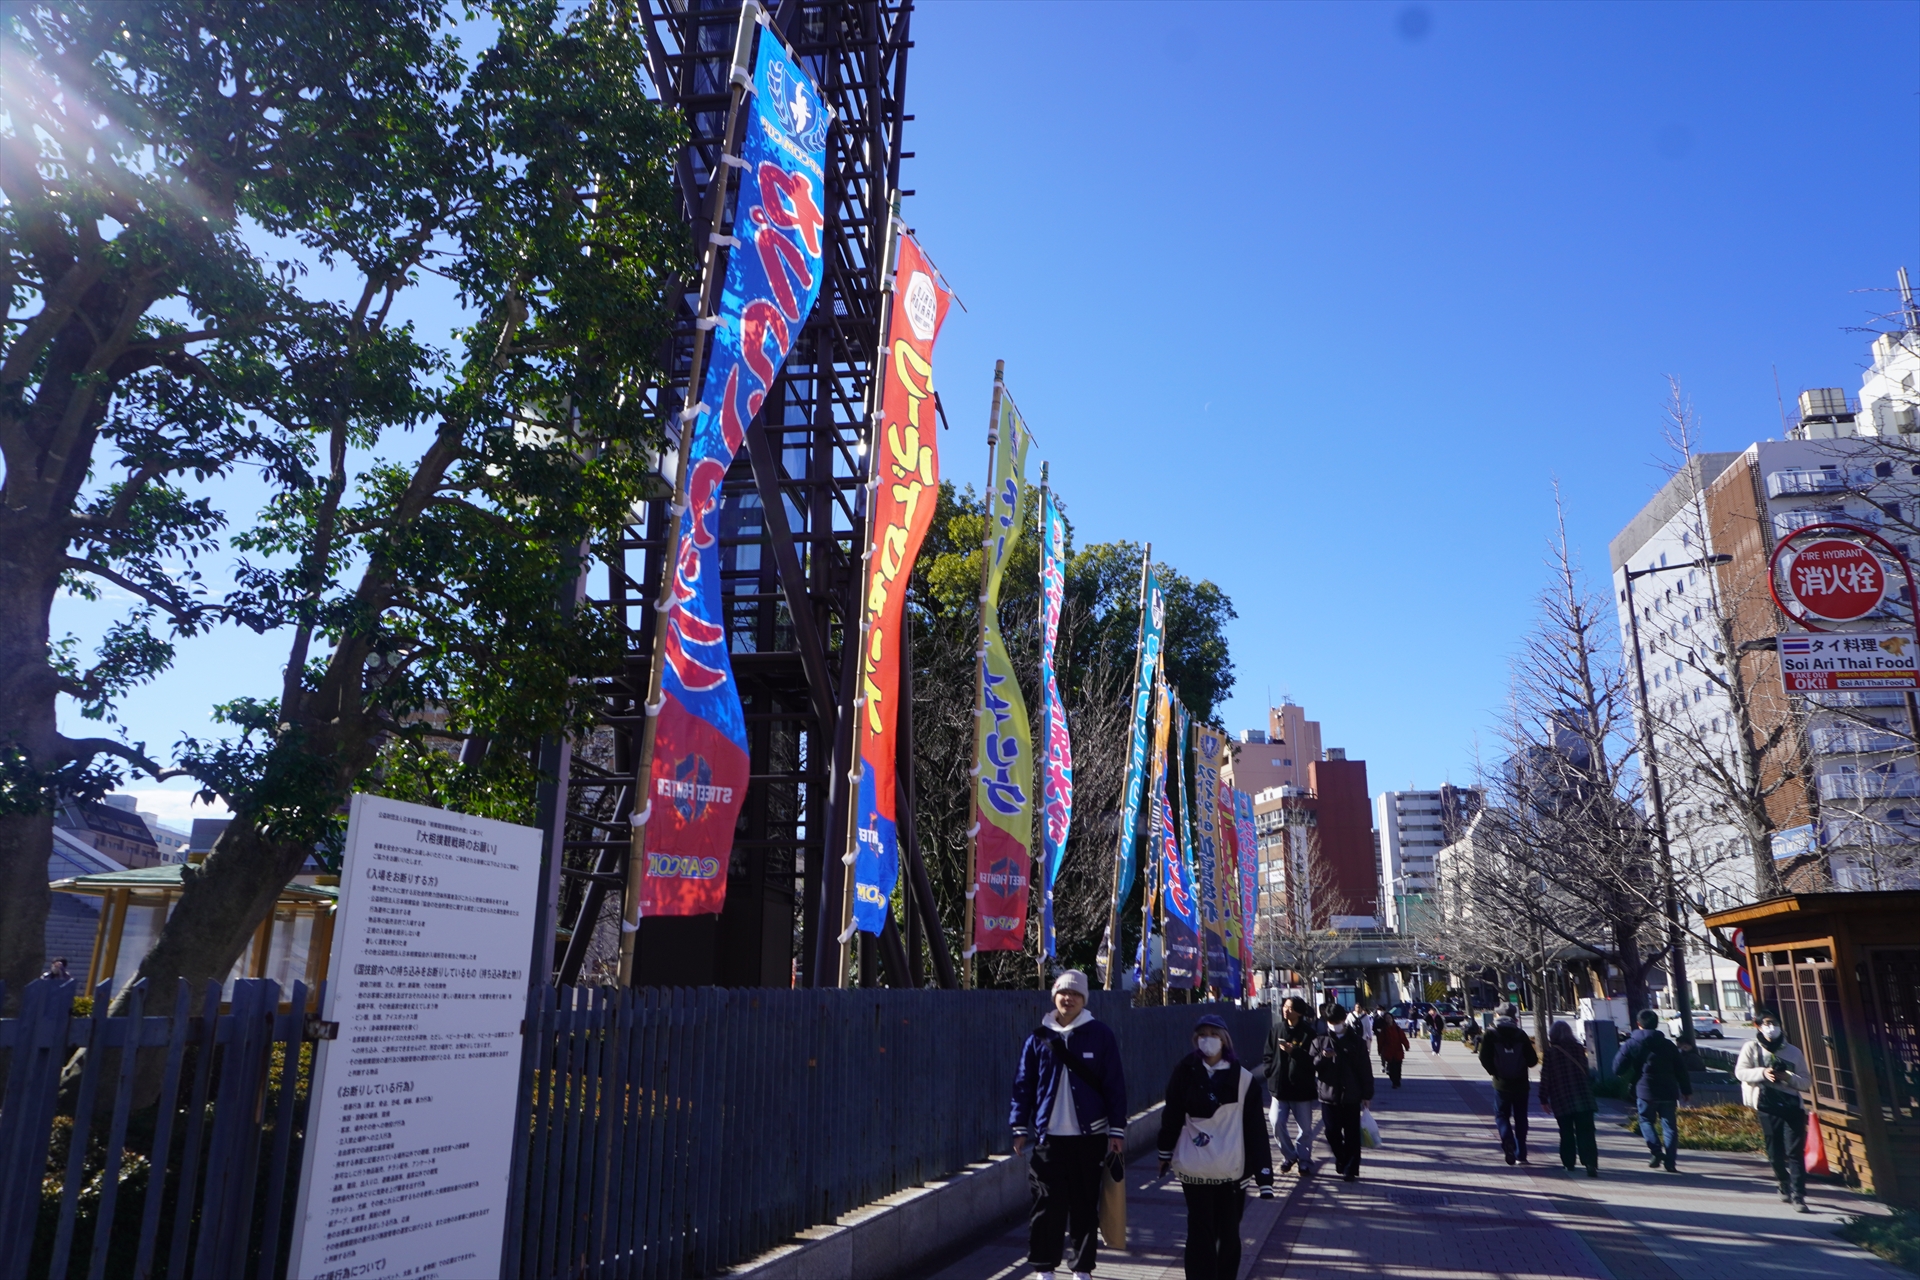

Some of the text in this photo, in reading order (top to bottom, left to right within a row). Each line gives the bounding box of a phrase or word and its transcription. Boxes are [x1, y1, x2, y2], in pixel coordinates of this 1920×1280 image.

[1801, 549, 1863, 561] FIRE HYDRANT
[1796, 562, 1879, 597] 消火栓
[1811, 638, 1879, 653] タイ料理
[1785, 656, 1914, 671] Soi Ari Thai Food
[1795, 679, 1828, 690] OK!!
[416, 830, 498, 855] 『大相撲観戦時のお願い』
[366, 868, 439, 887] 《入場をお断りする方》
[337, 1081, 414, 1098] 《お断りしている行為》
